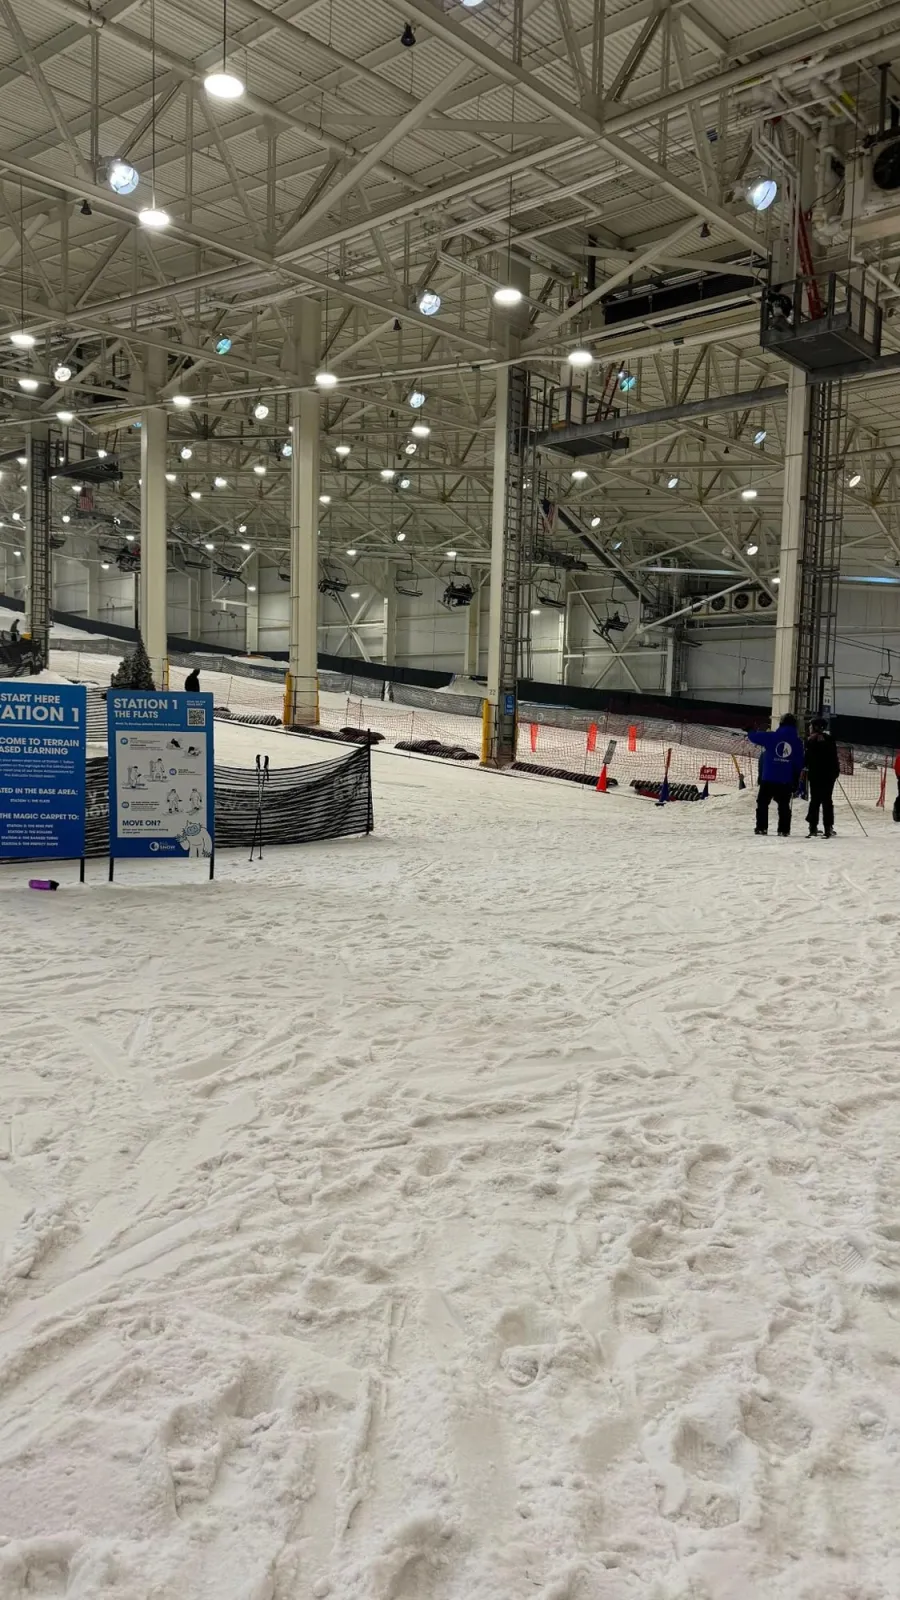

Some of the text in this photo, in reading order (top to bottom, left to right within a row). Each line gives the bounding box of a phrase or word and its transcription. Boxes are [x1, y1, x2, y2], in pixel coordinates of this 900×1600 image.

[1, 693, 60, 704] START HERE
[114, 698, 168, 710] STATION
[172, 700, 178, 710] 1
[0, 705, 79, 723] ATION 1
[114, 710, 131, 718] THE
[28, 738, 40, 746] TO
[43, 738, 79, 747] TERRAIN
[24, 746, 68, 755] LEARNING
